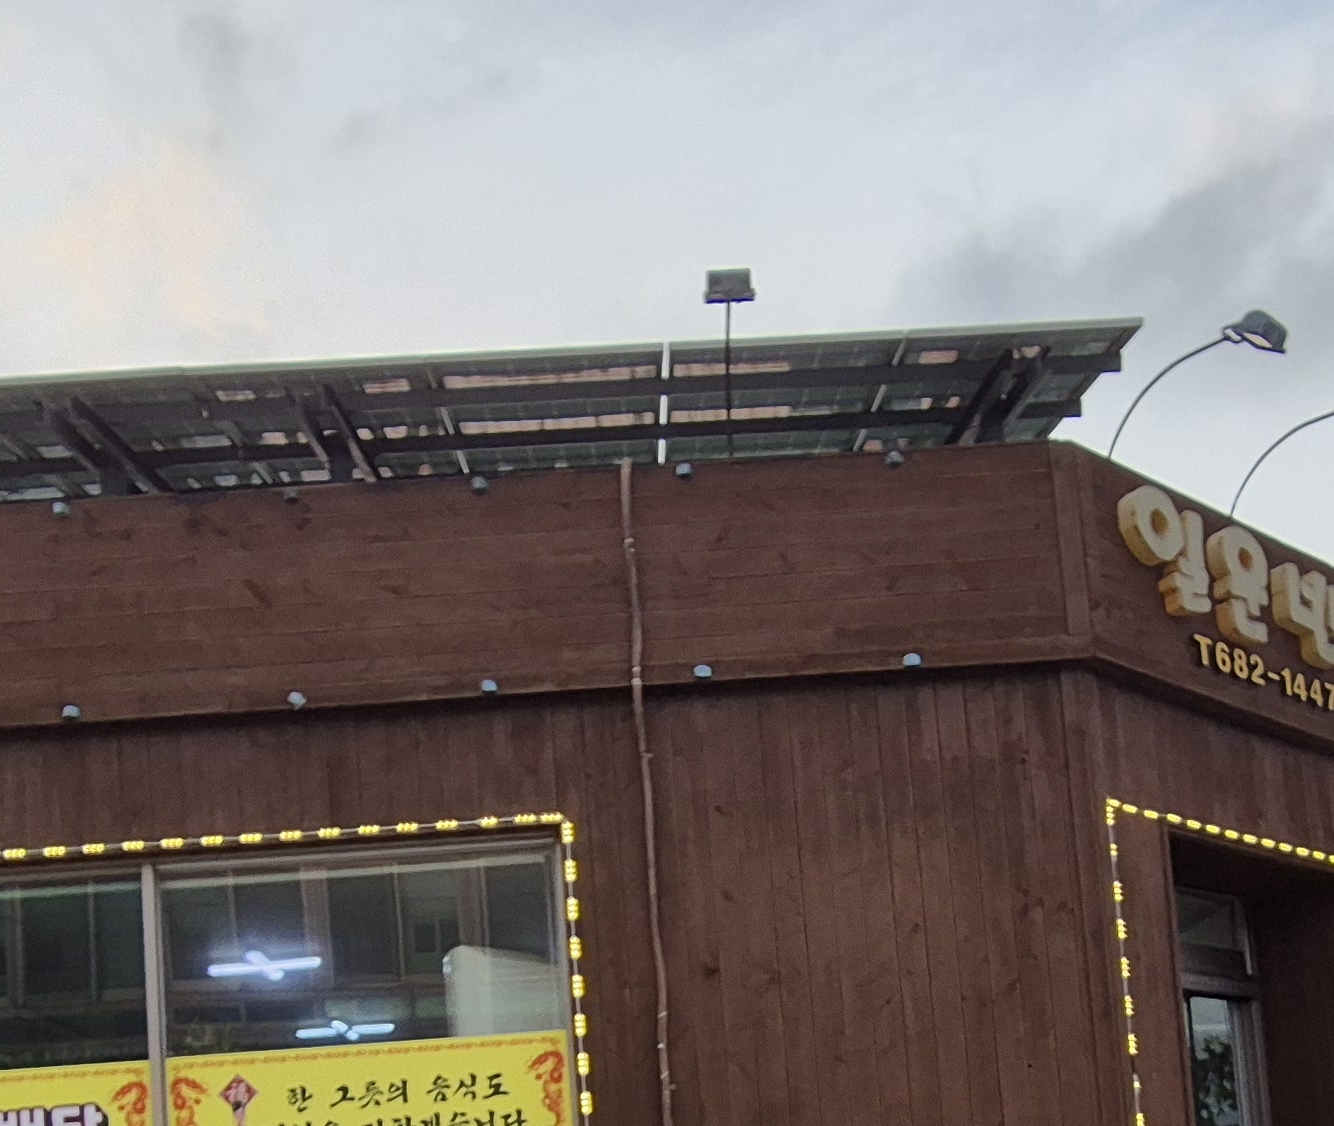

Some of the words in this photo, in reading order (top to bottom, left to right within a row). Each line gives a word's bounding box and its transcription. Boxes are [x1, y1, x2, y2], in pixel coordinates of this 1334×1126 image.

[286, 1084, 314, 1112] 한
[330, 1077, 410, 1111] 그릇의
[427, 1071, 510, 1102] 음식도
